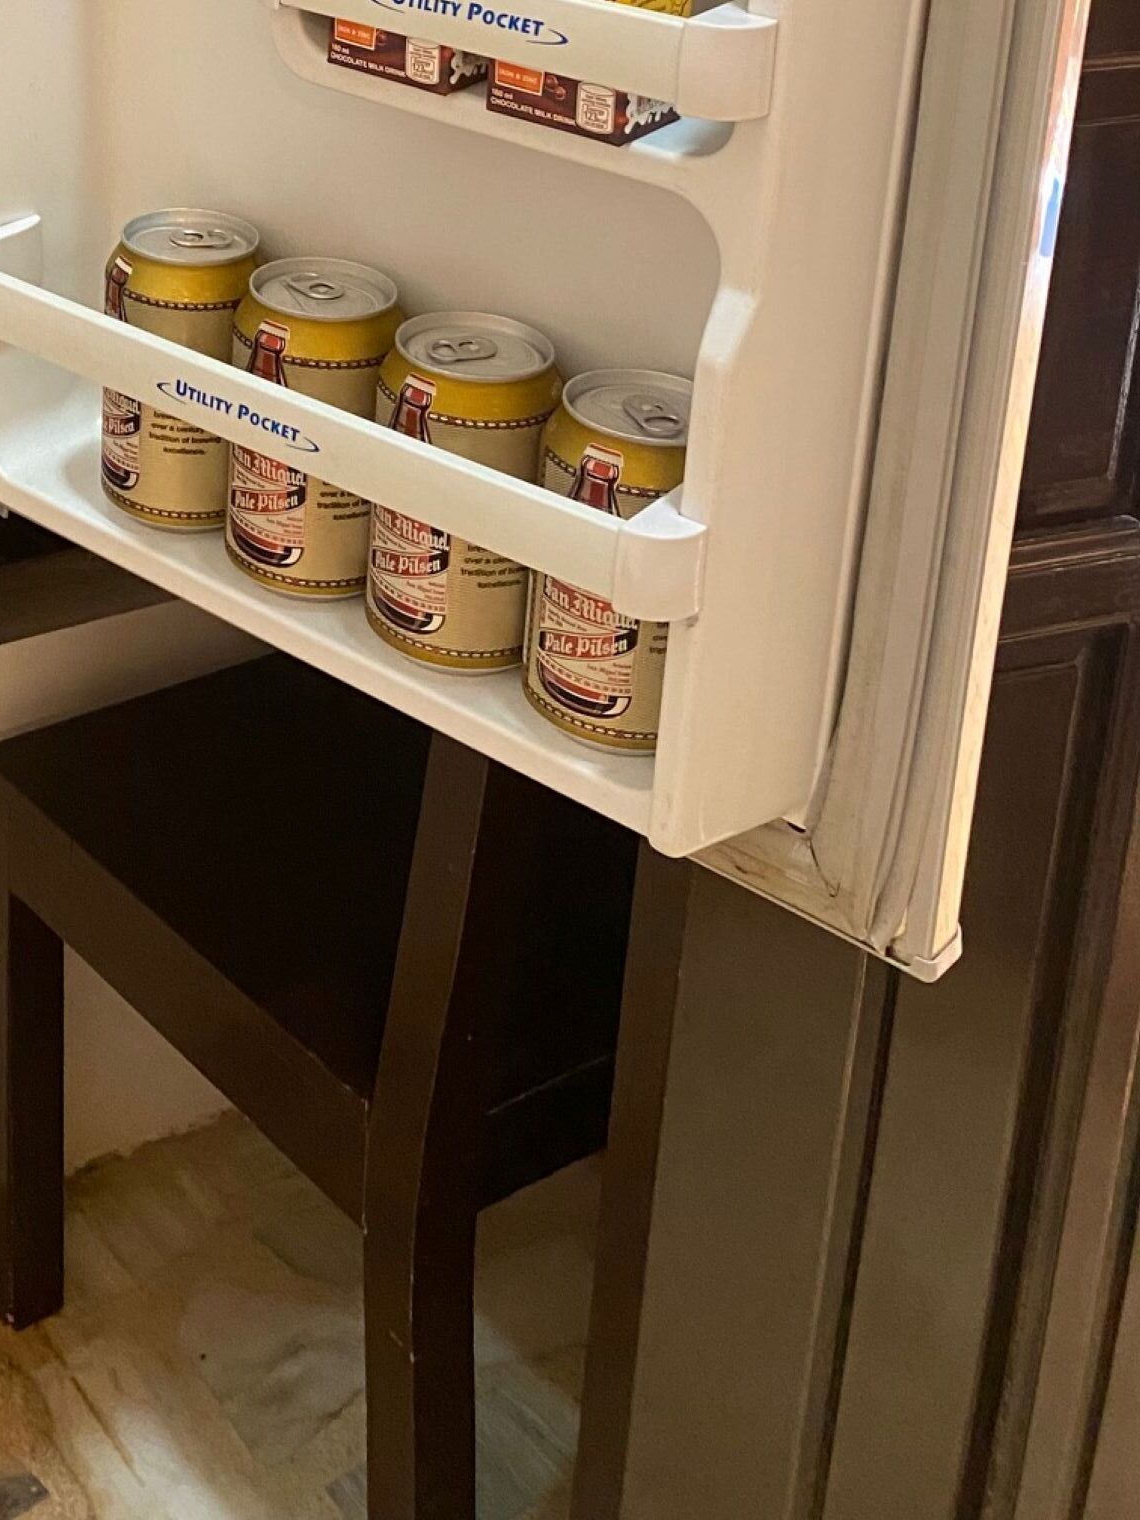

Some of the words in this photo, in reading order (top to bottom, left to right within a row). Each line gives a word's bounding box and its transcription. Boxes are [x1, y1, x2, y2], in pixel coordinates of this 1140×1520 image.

[466, 2, 545, 38] POCKET
[330, 52, 368, 70] CHOCOLATE
[368, 61, 384, 73] MILK
[490, 95, 534, 115] CHOCOLATE
[534, 108, 553, 120] MILK
[175, 378, 234, 416] UTILITY
[237, 403, 302, 444] POCKET
[234, 490, 256, 510] Pale
[256, 492, 299, 514] Pilsen
[374, 550, 396, 570] Pale
[397, 554, 441, 576] Pilsen
[461, 567, 497, 577] tradition
[544, 632, 573, 655] Pale
[574, 636, 628, 658] Pilsen
